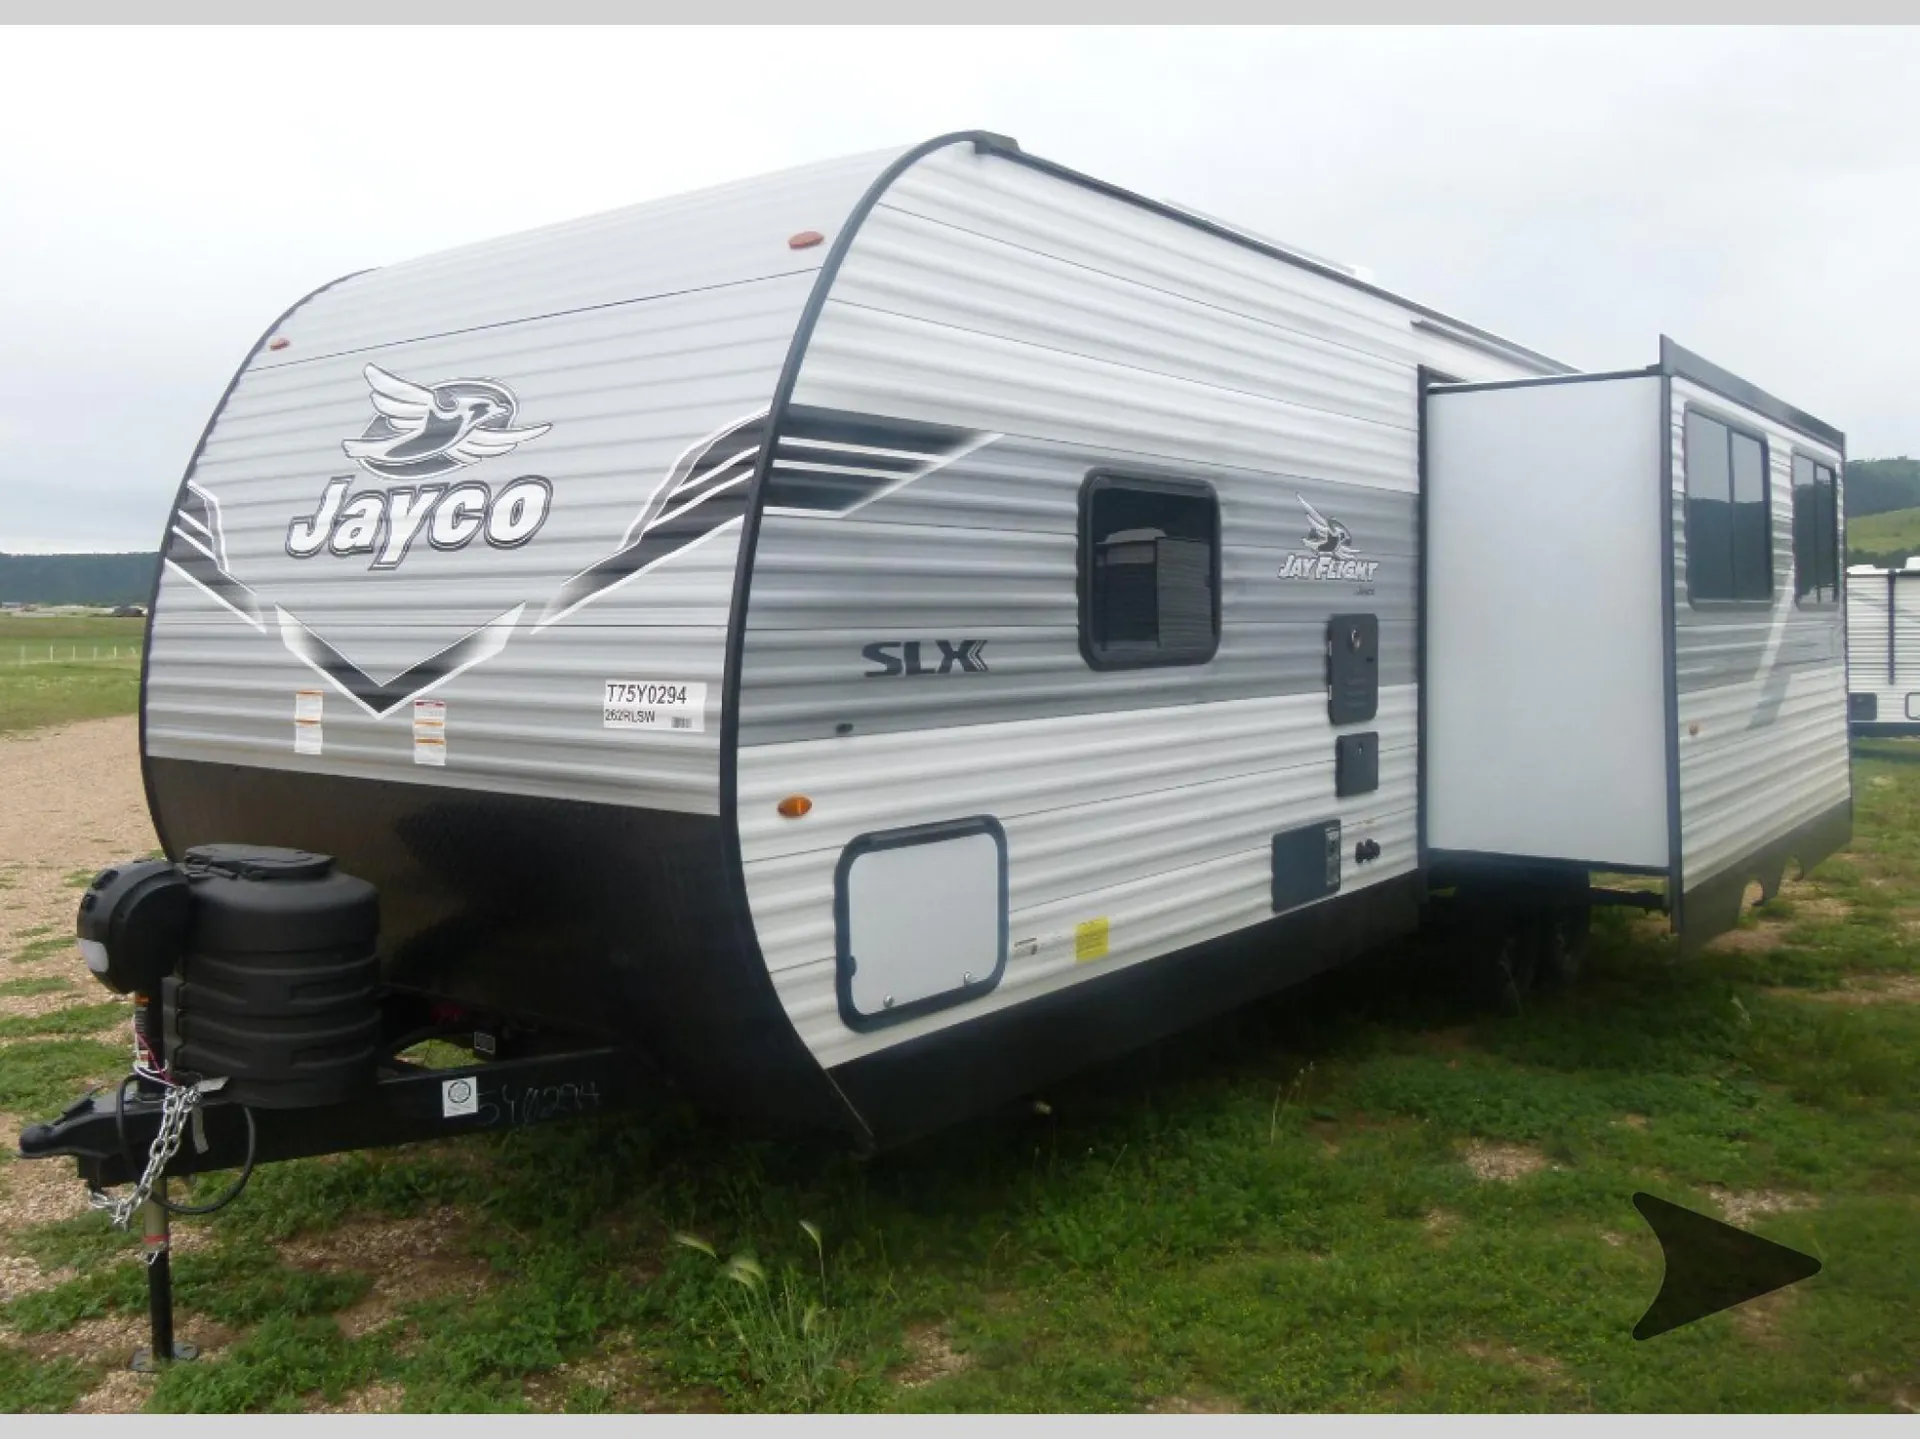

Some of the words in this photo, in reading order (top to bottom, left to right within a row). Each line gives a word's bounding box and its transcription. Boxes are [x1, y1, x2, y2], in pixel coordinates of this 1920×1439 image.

[285, 474, 553, 571] Jayco
[862, 639, 988, 678] SLX
[606, 684, 687, 704] T75Y0294
[605, 708, 655, 723] 262RLSW
